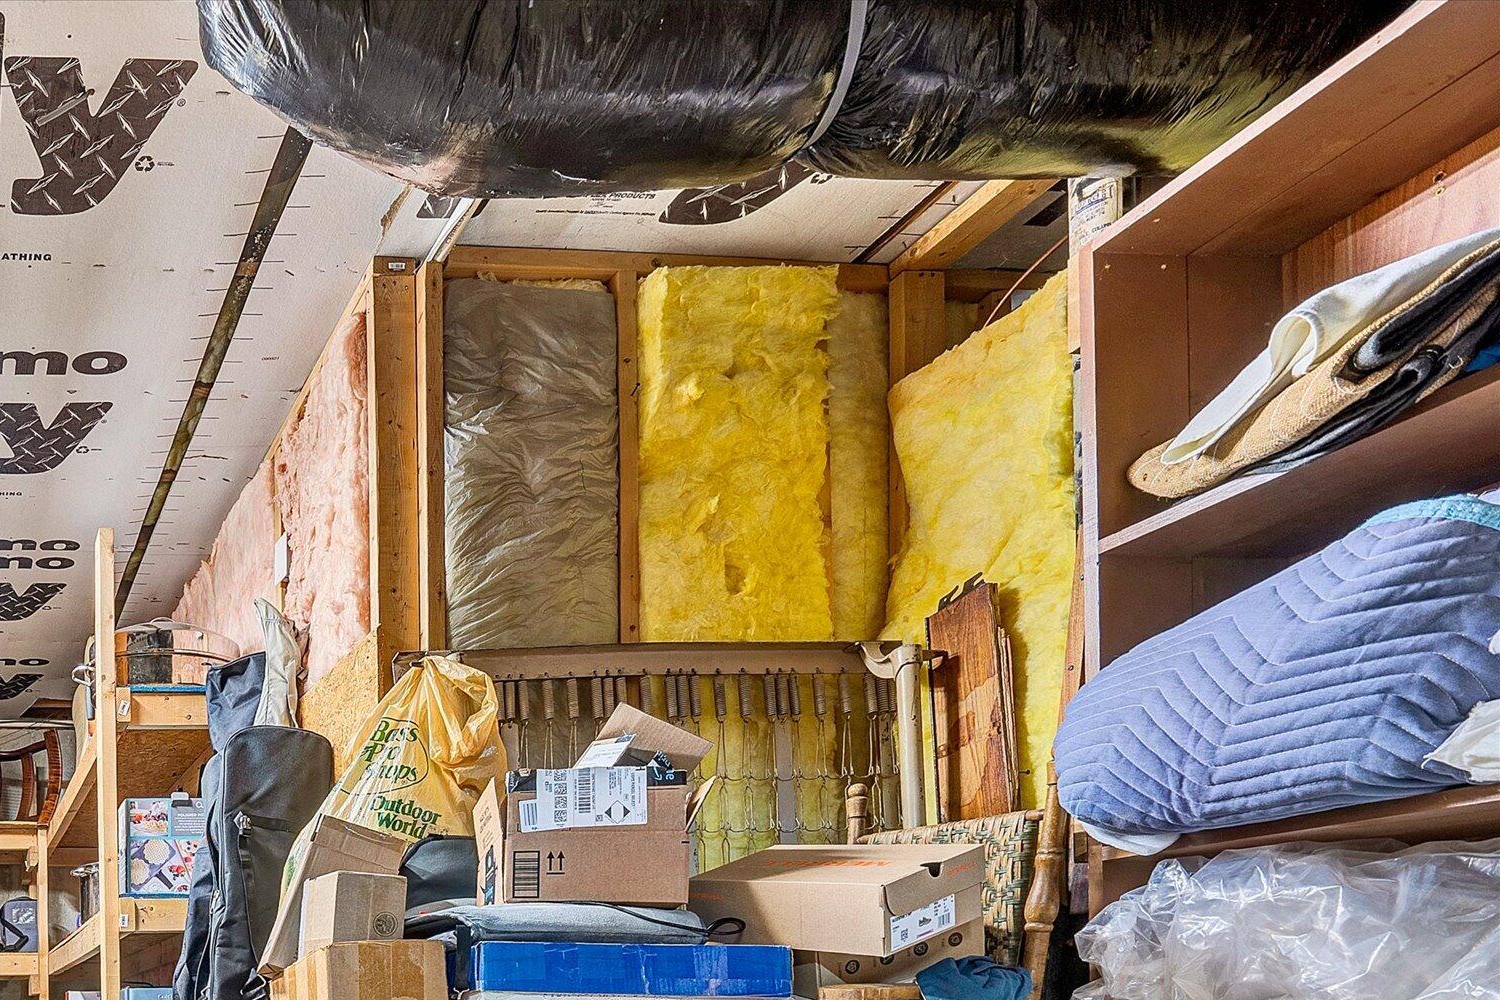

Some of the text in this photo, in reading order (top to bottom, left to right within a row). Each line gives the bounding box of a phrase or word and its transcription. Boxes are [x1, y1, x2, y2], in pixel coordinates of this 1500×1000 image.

[370, 720, 419, 742] Bass
[371, 796, 442, 825] Outdoor
[378, 812, 429, 839] World
